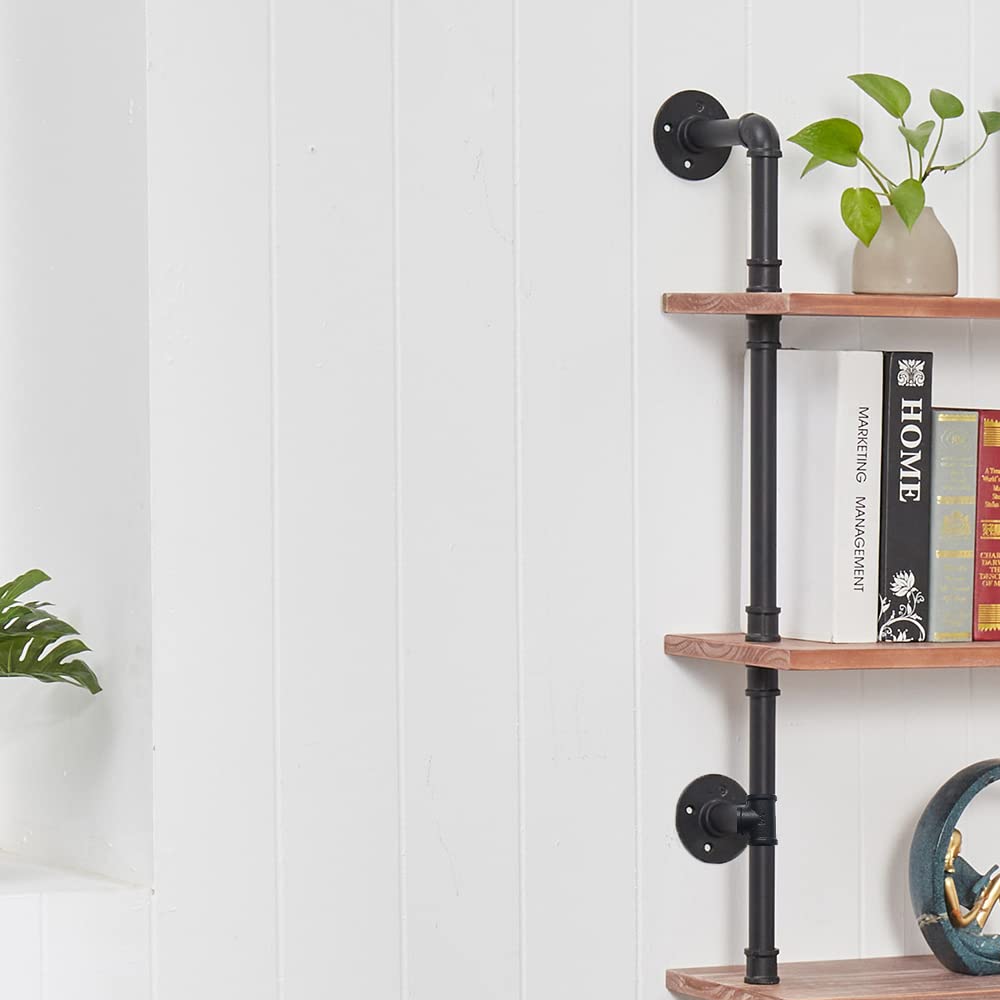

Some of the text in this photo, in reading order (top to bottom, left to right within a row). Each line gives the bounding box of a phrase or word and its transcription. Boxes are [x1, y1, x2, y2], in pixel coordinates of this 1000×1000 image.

[853, 406, 869, 592] MARKETING MANAGEMENT
[898, 397, 923, 503] HOME
